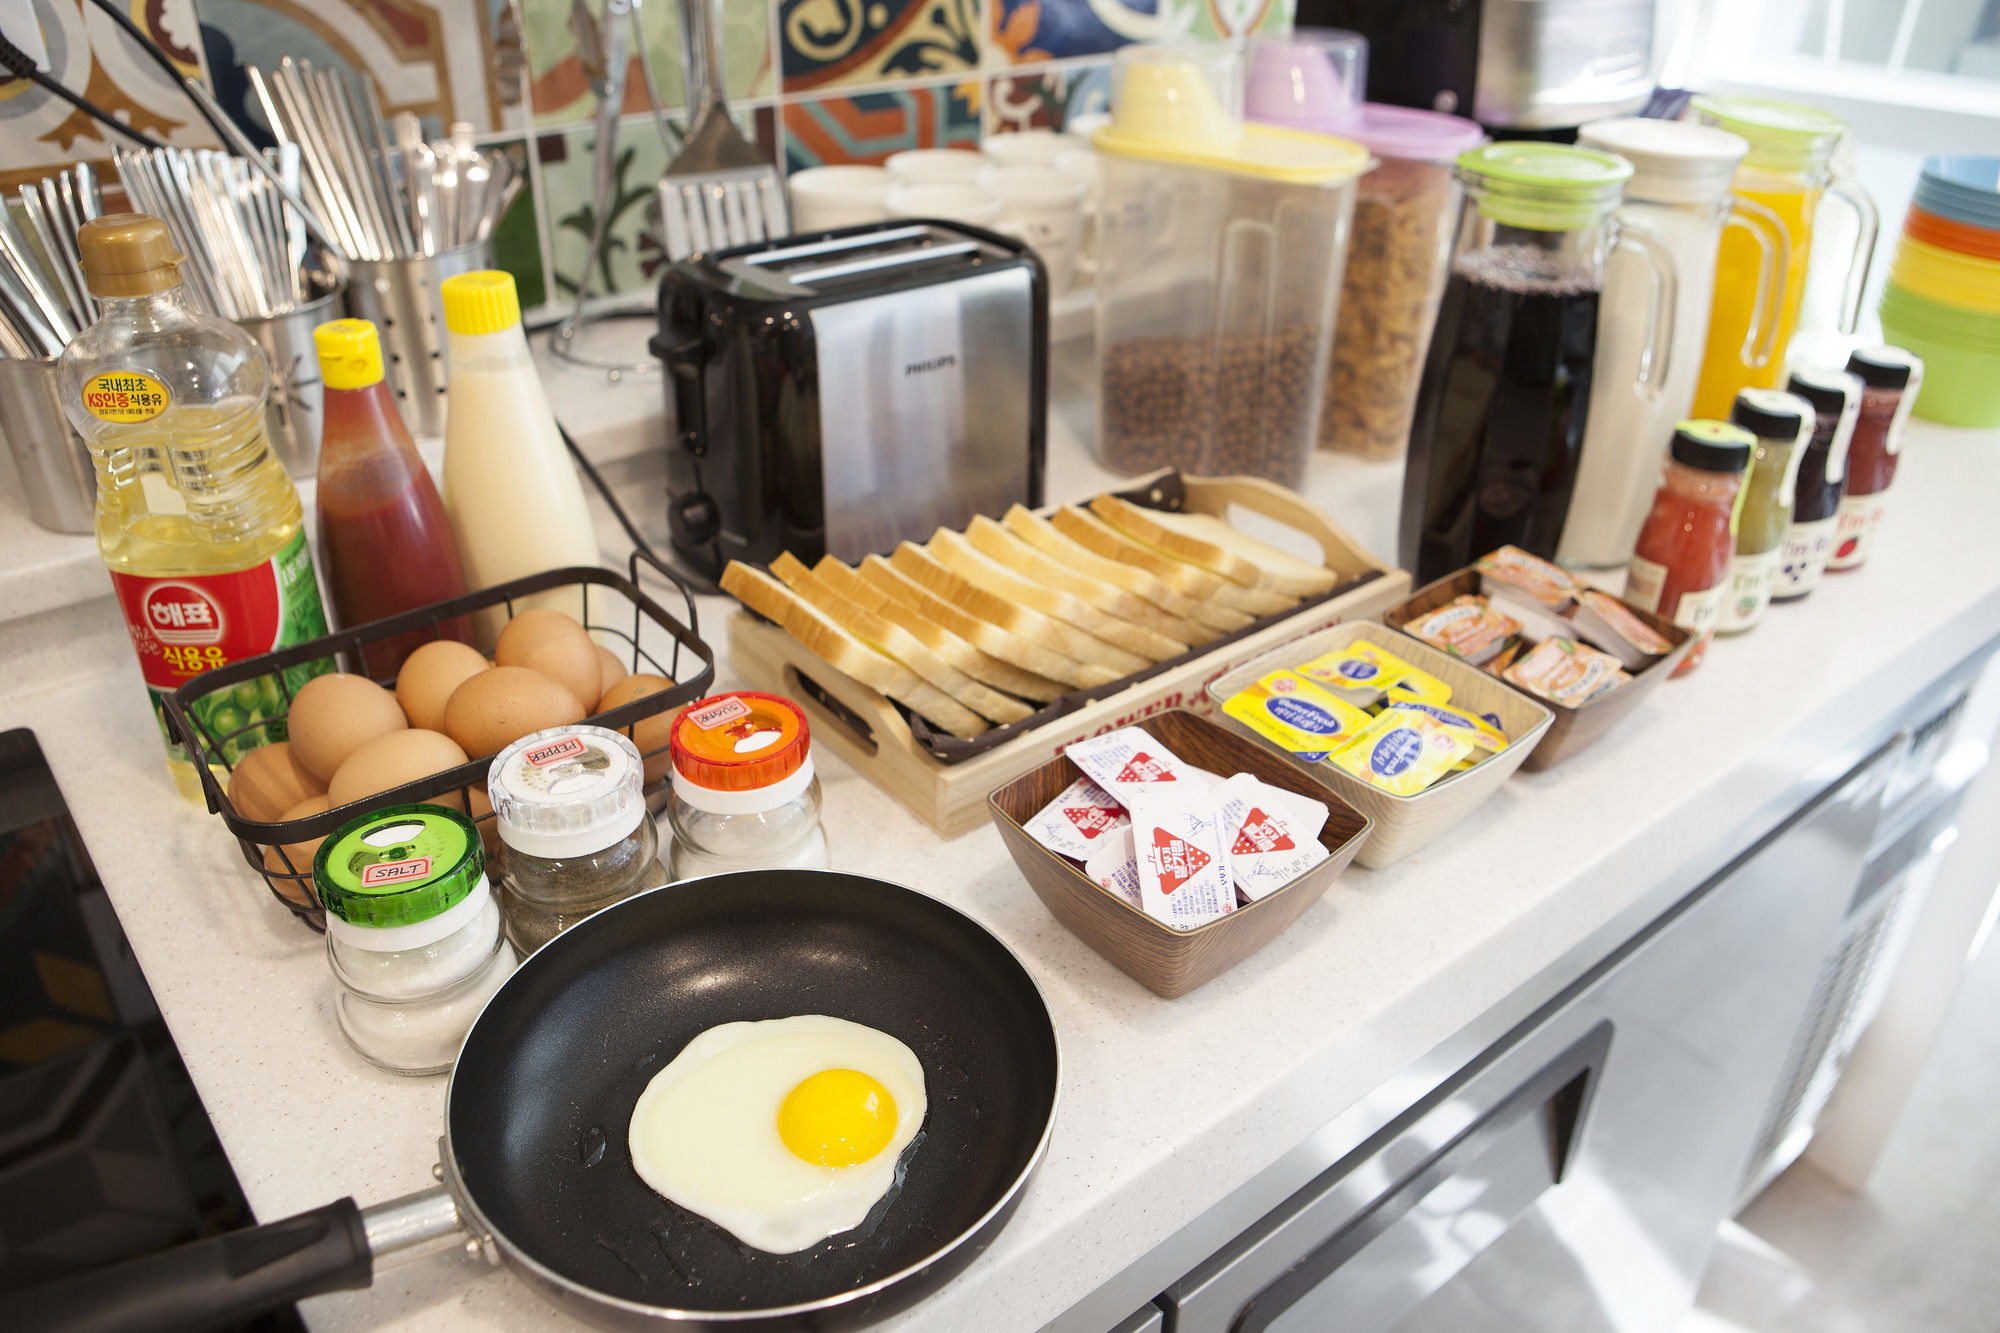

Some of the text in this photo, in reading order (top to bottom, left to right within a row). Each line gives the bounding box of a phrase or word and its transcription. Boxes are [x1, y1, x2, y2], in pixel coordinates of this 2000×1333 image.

[98, 378, 148, 392] 국내최초
[88, 392, 129, 408] KS인증
[150, 602, 213, 628] 해표
[163, 646, 229, 671] 식용유
[528, 739, 579, 763] PEPPER
[375, 863, 422, 878] SALT
[1161, 847, 1177, 873] 오뚜기
[1169, 839, 1189, 880] 딸기잼
